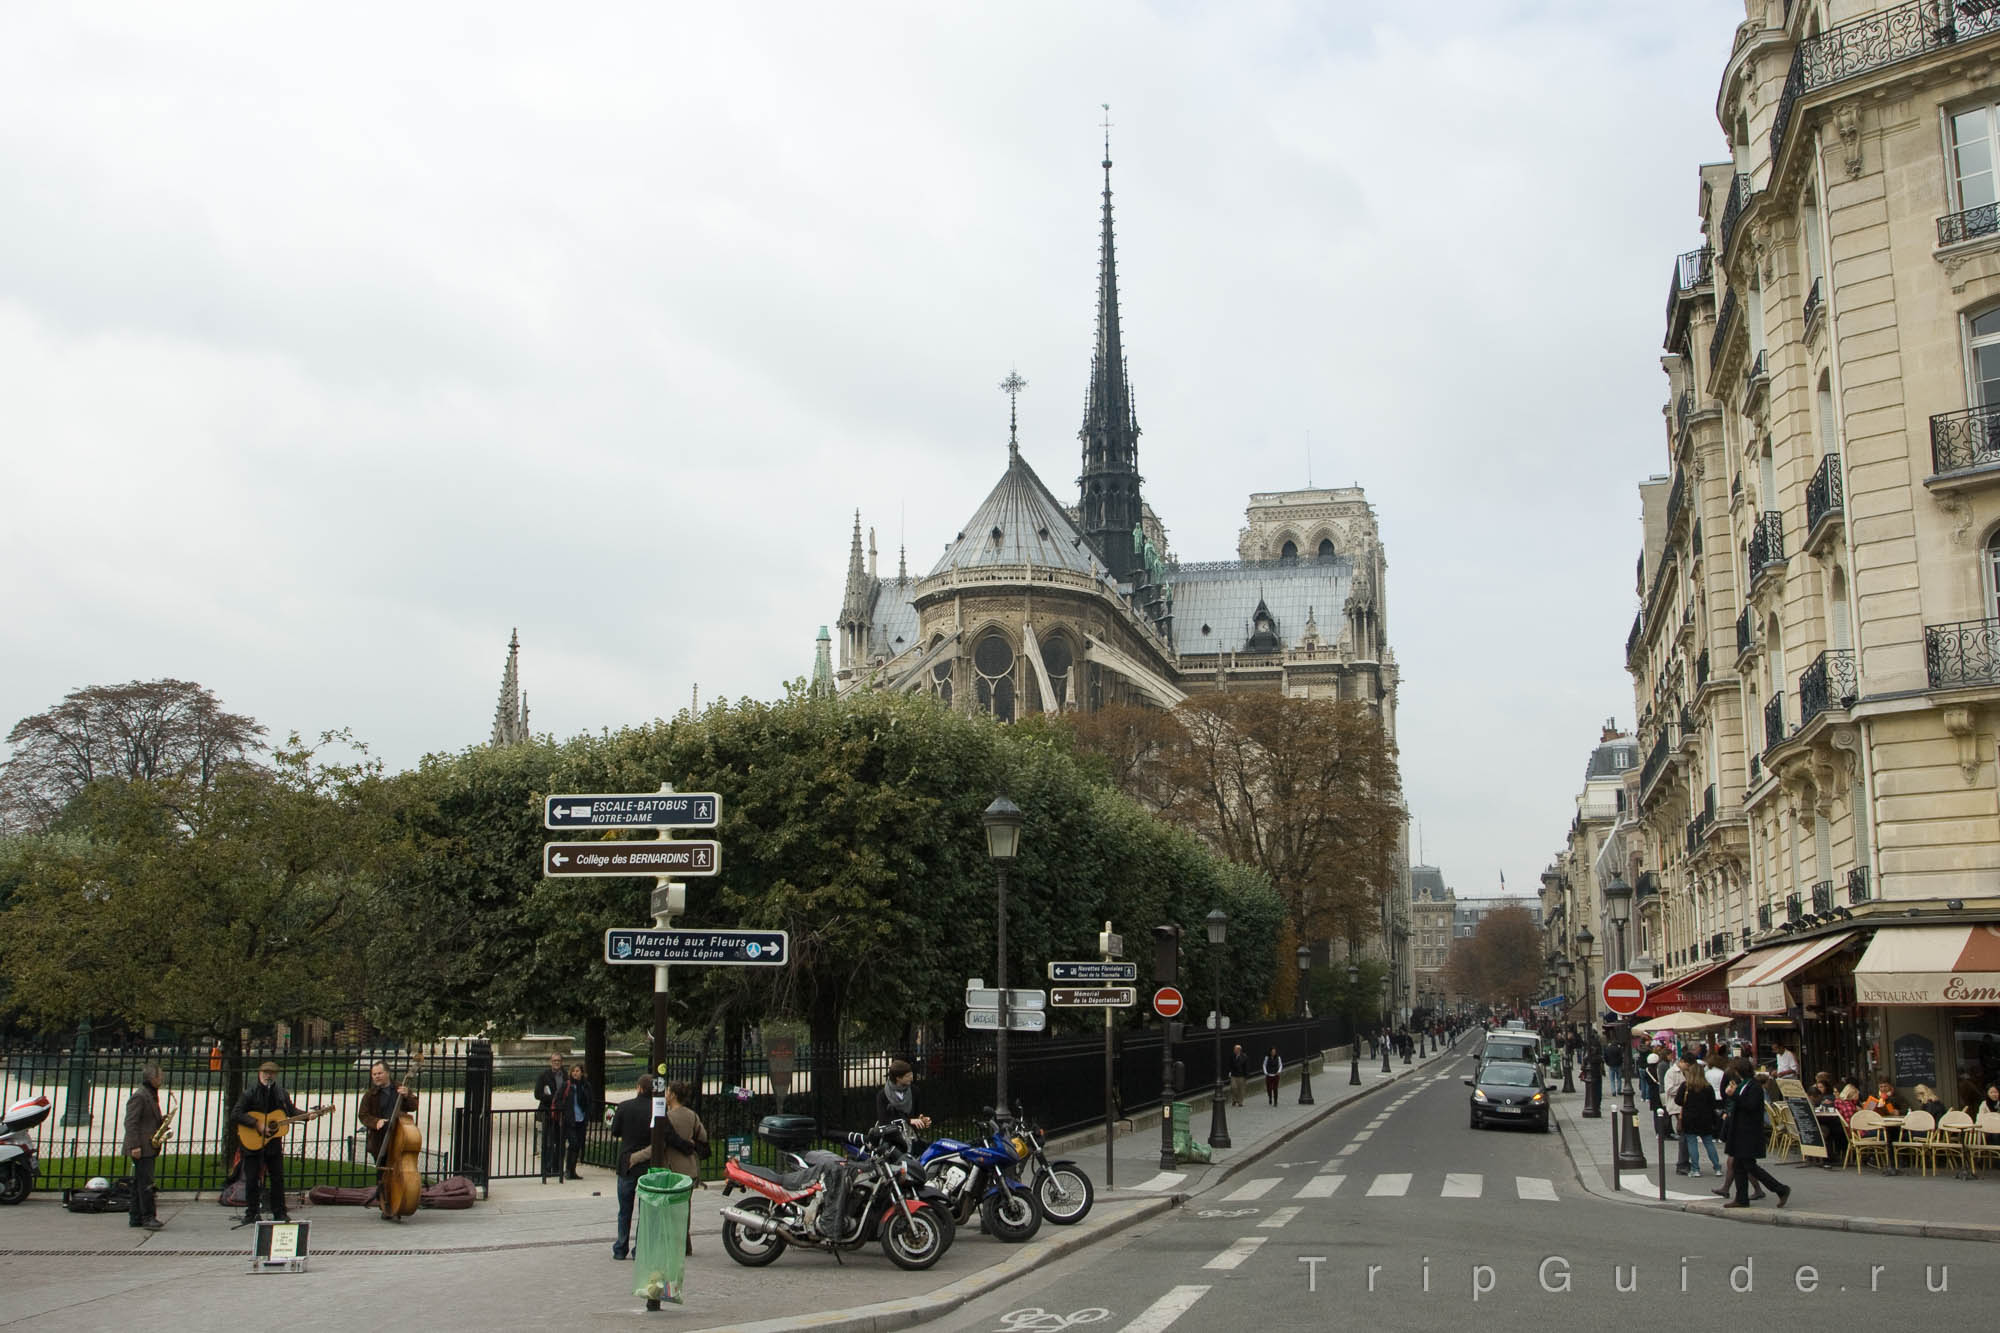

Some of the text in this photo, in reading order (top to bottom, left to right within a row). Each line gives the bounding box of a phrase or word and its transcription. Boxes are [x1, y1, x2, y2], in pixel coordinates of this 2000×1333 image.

[592, 800, 688, 812] ESCALE-BATOBUS
[591, 813, 653, 823] NOTRE-DAME
[576, 852, 690, 867] Collège des BERNARDINS
[635, 935, 747, 947] Marché aux Fleurs
[634, 948, 724, 959] Place Louis Lépine
[1863, 976, 2000, 1001] RESTAURANT Esm
